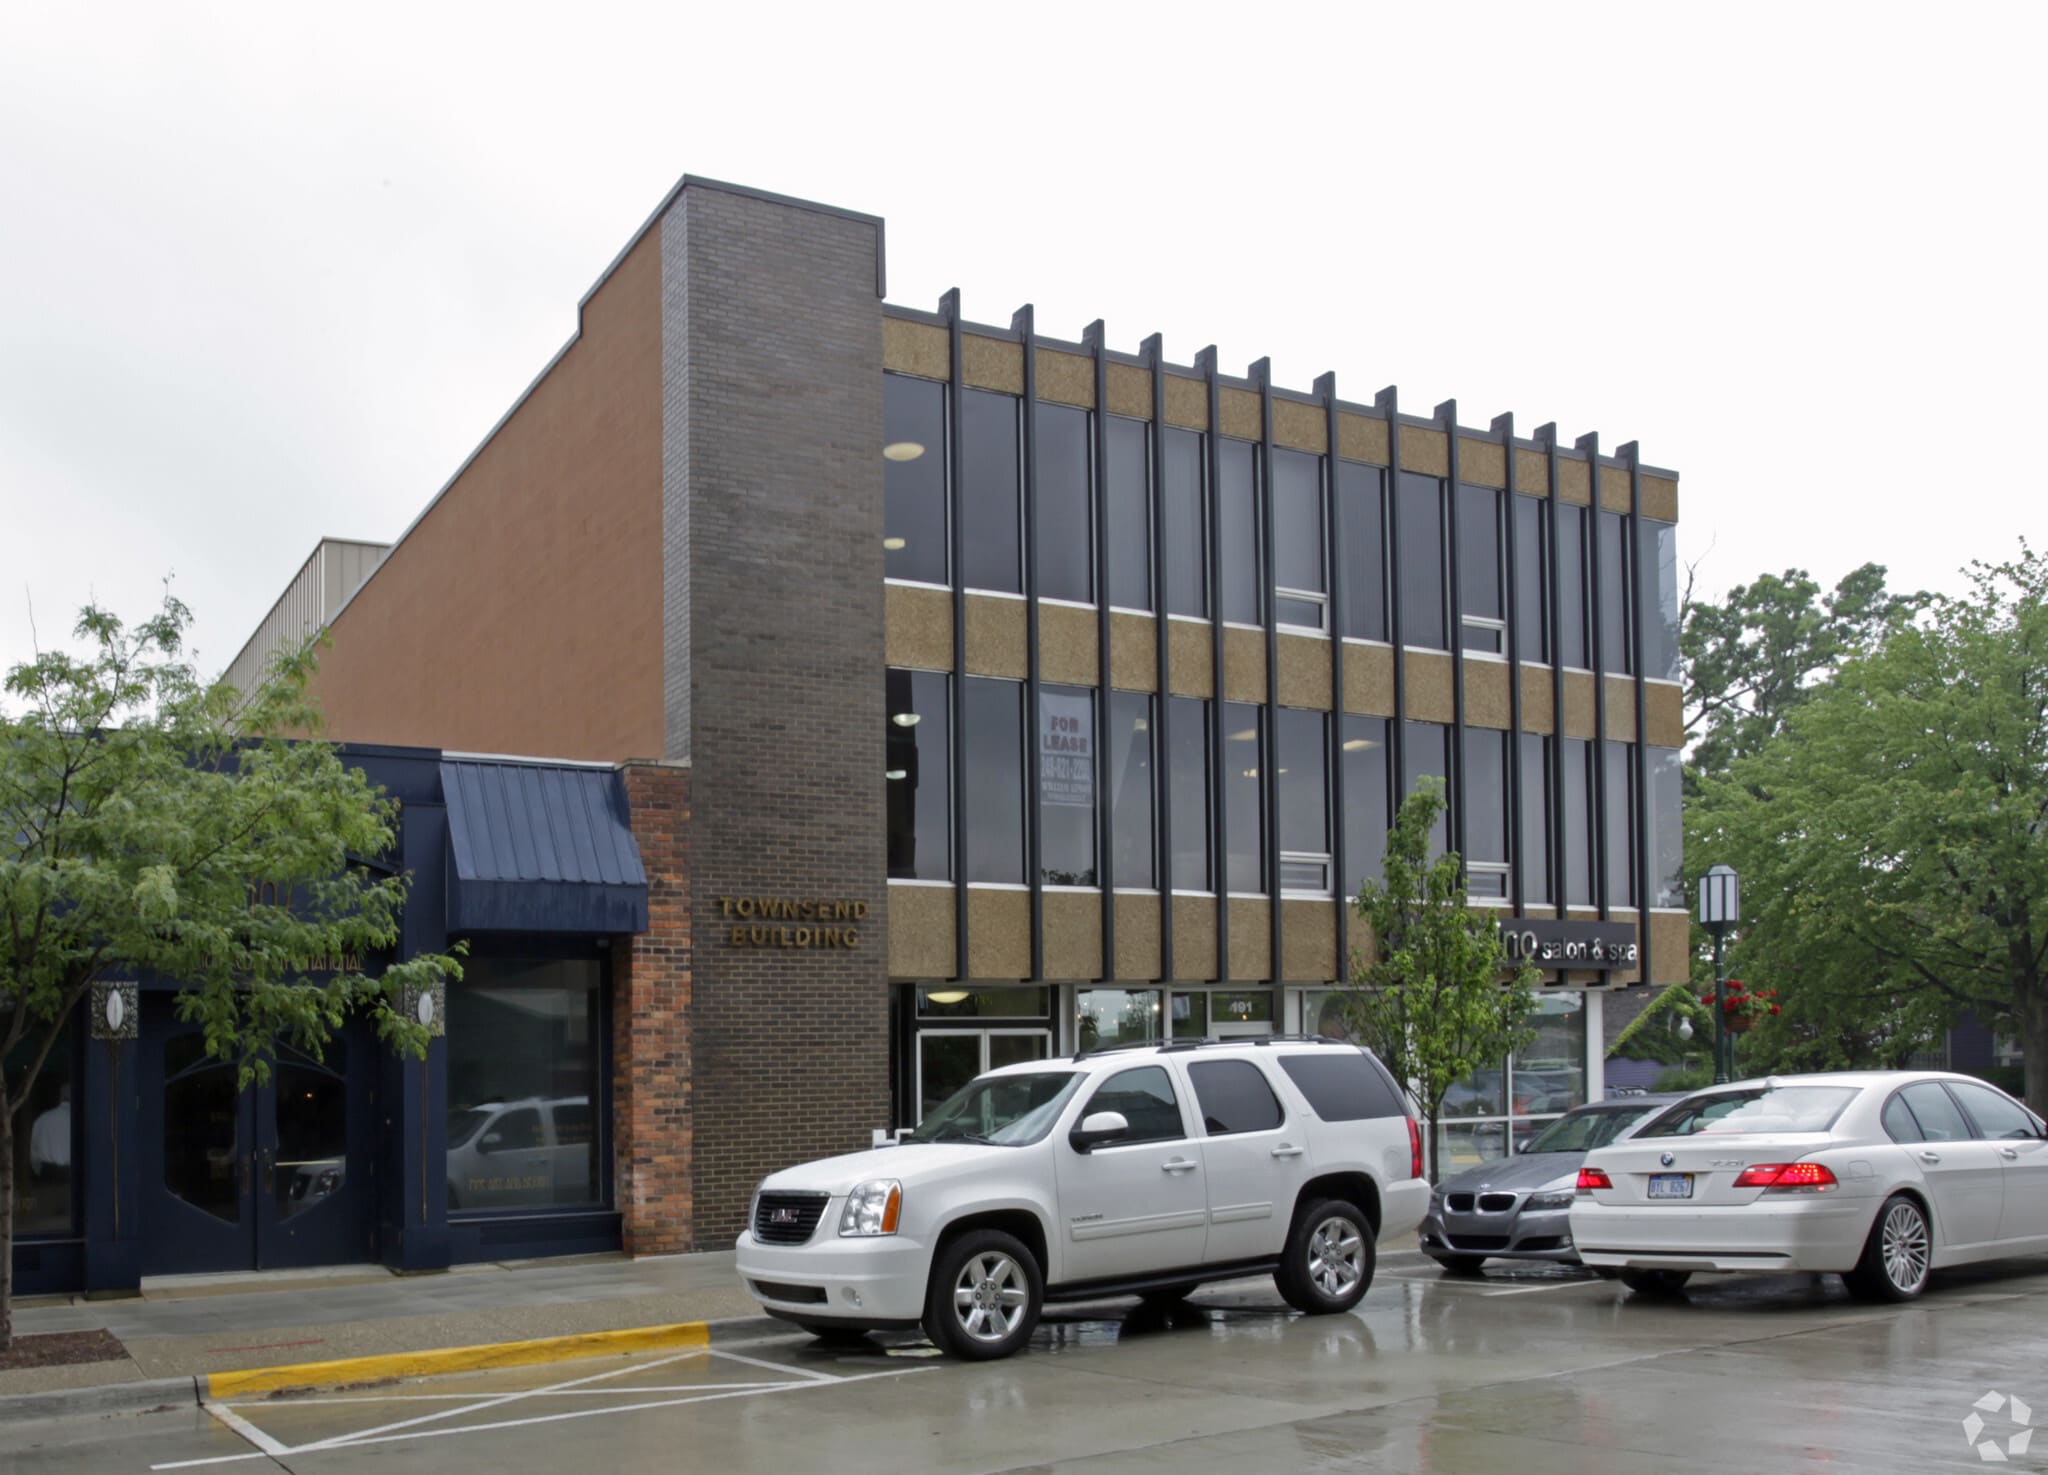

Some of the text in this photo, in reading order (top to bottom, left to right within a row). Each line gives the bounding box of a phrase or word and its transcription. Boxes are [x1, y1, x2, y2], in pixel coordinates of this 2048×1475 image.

[1050, 715, 1079, 734] FOR
[1043, 735, 1087, 752] LEASE
[719, 896, 870, 920] TOWNSEND
[731, 925, 860, 948] BUILDING
[1542, 937, 1587, 960] salon
[1592, 938, 1605, 960] &
[1608, 943, 1638, 966] spa
[1231, 1001, 1253, 1013] 191
